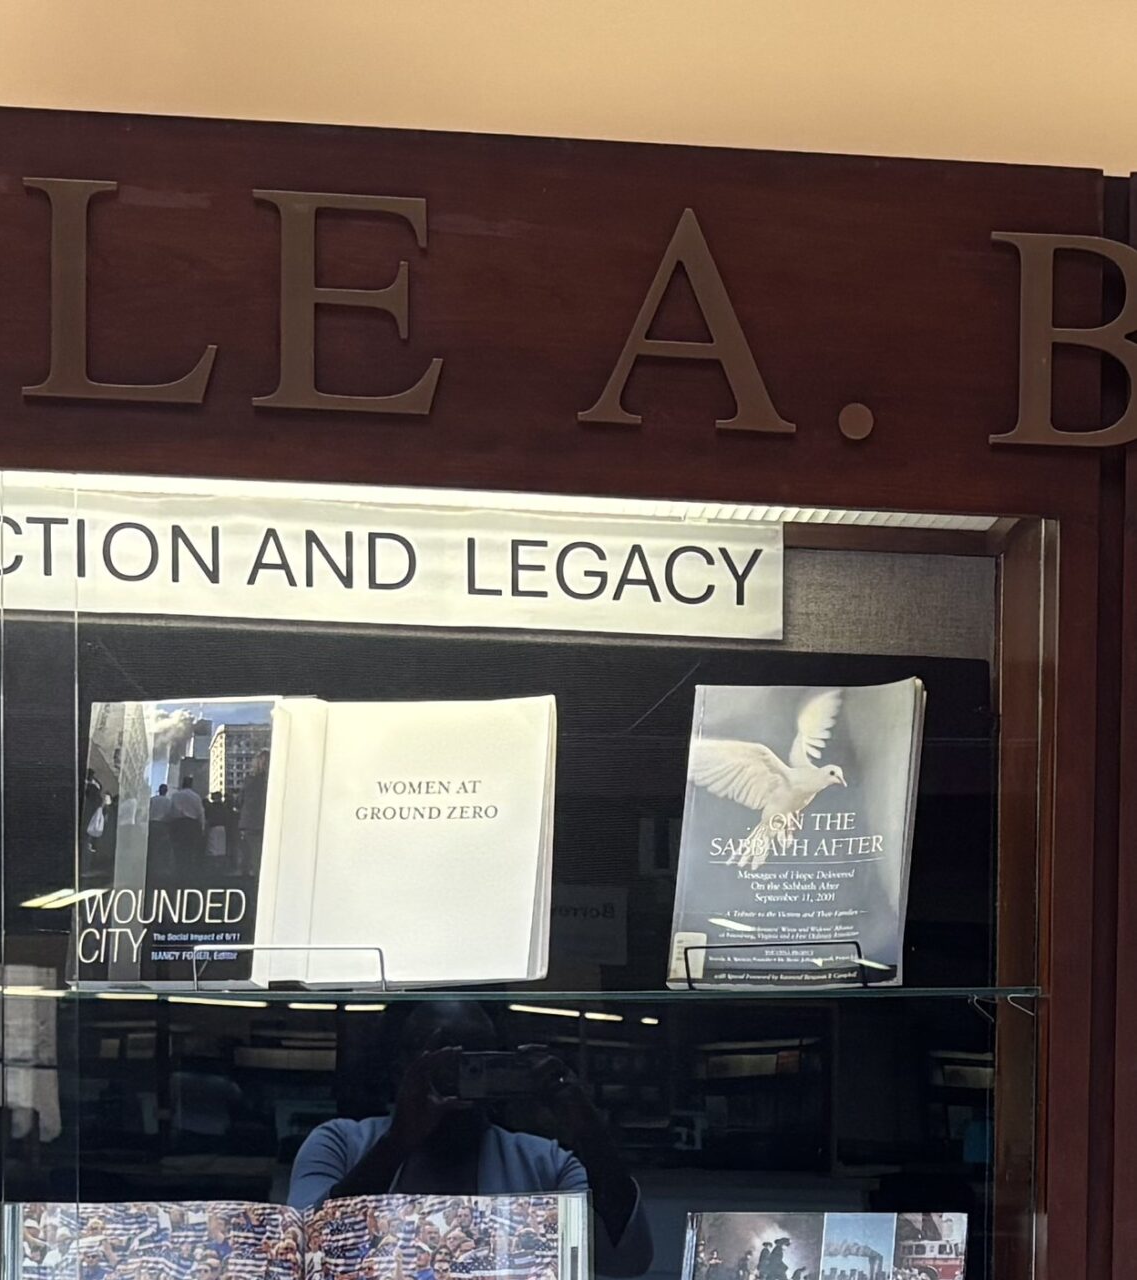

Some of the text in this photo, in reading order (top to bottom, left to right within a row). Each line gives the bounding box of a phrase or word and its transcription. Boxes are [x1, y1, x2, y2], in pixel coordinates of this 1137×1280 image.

[576, 207, 875, 440] A.
[989, 230, 1137, 449] B
[247, 527, 418, 592] AND
[466, 538, 764, 607] LEGACY
[376, 779, 482, 796] WOMEN AT
[355, 804, 499, 821] GROUND ZERO
[811, 812, 857, 831] THE
[709, 835, 884, 857] SABBATH AFTER
[82, 889, 246, 925] WOUNDED
[78, 928, 148, 964] CITY
